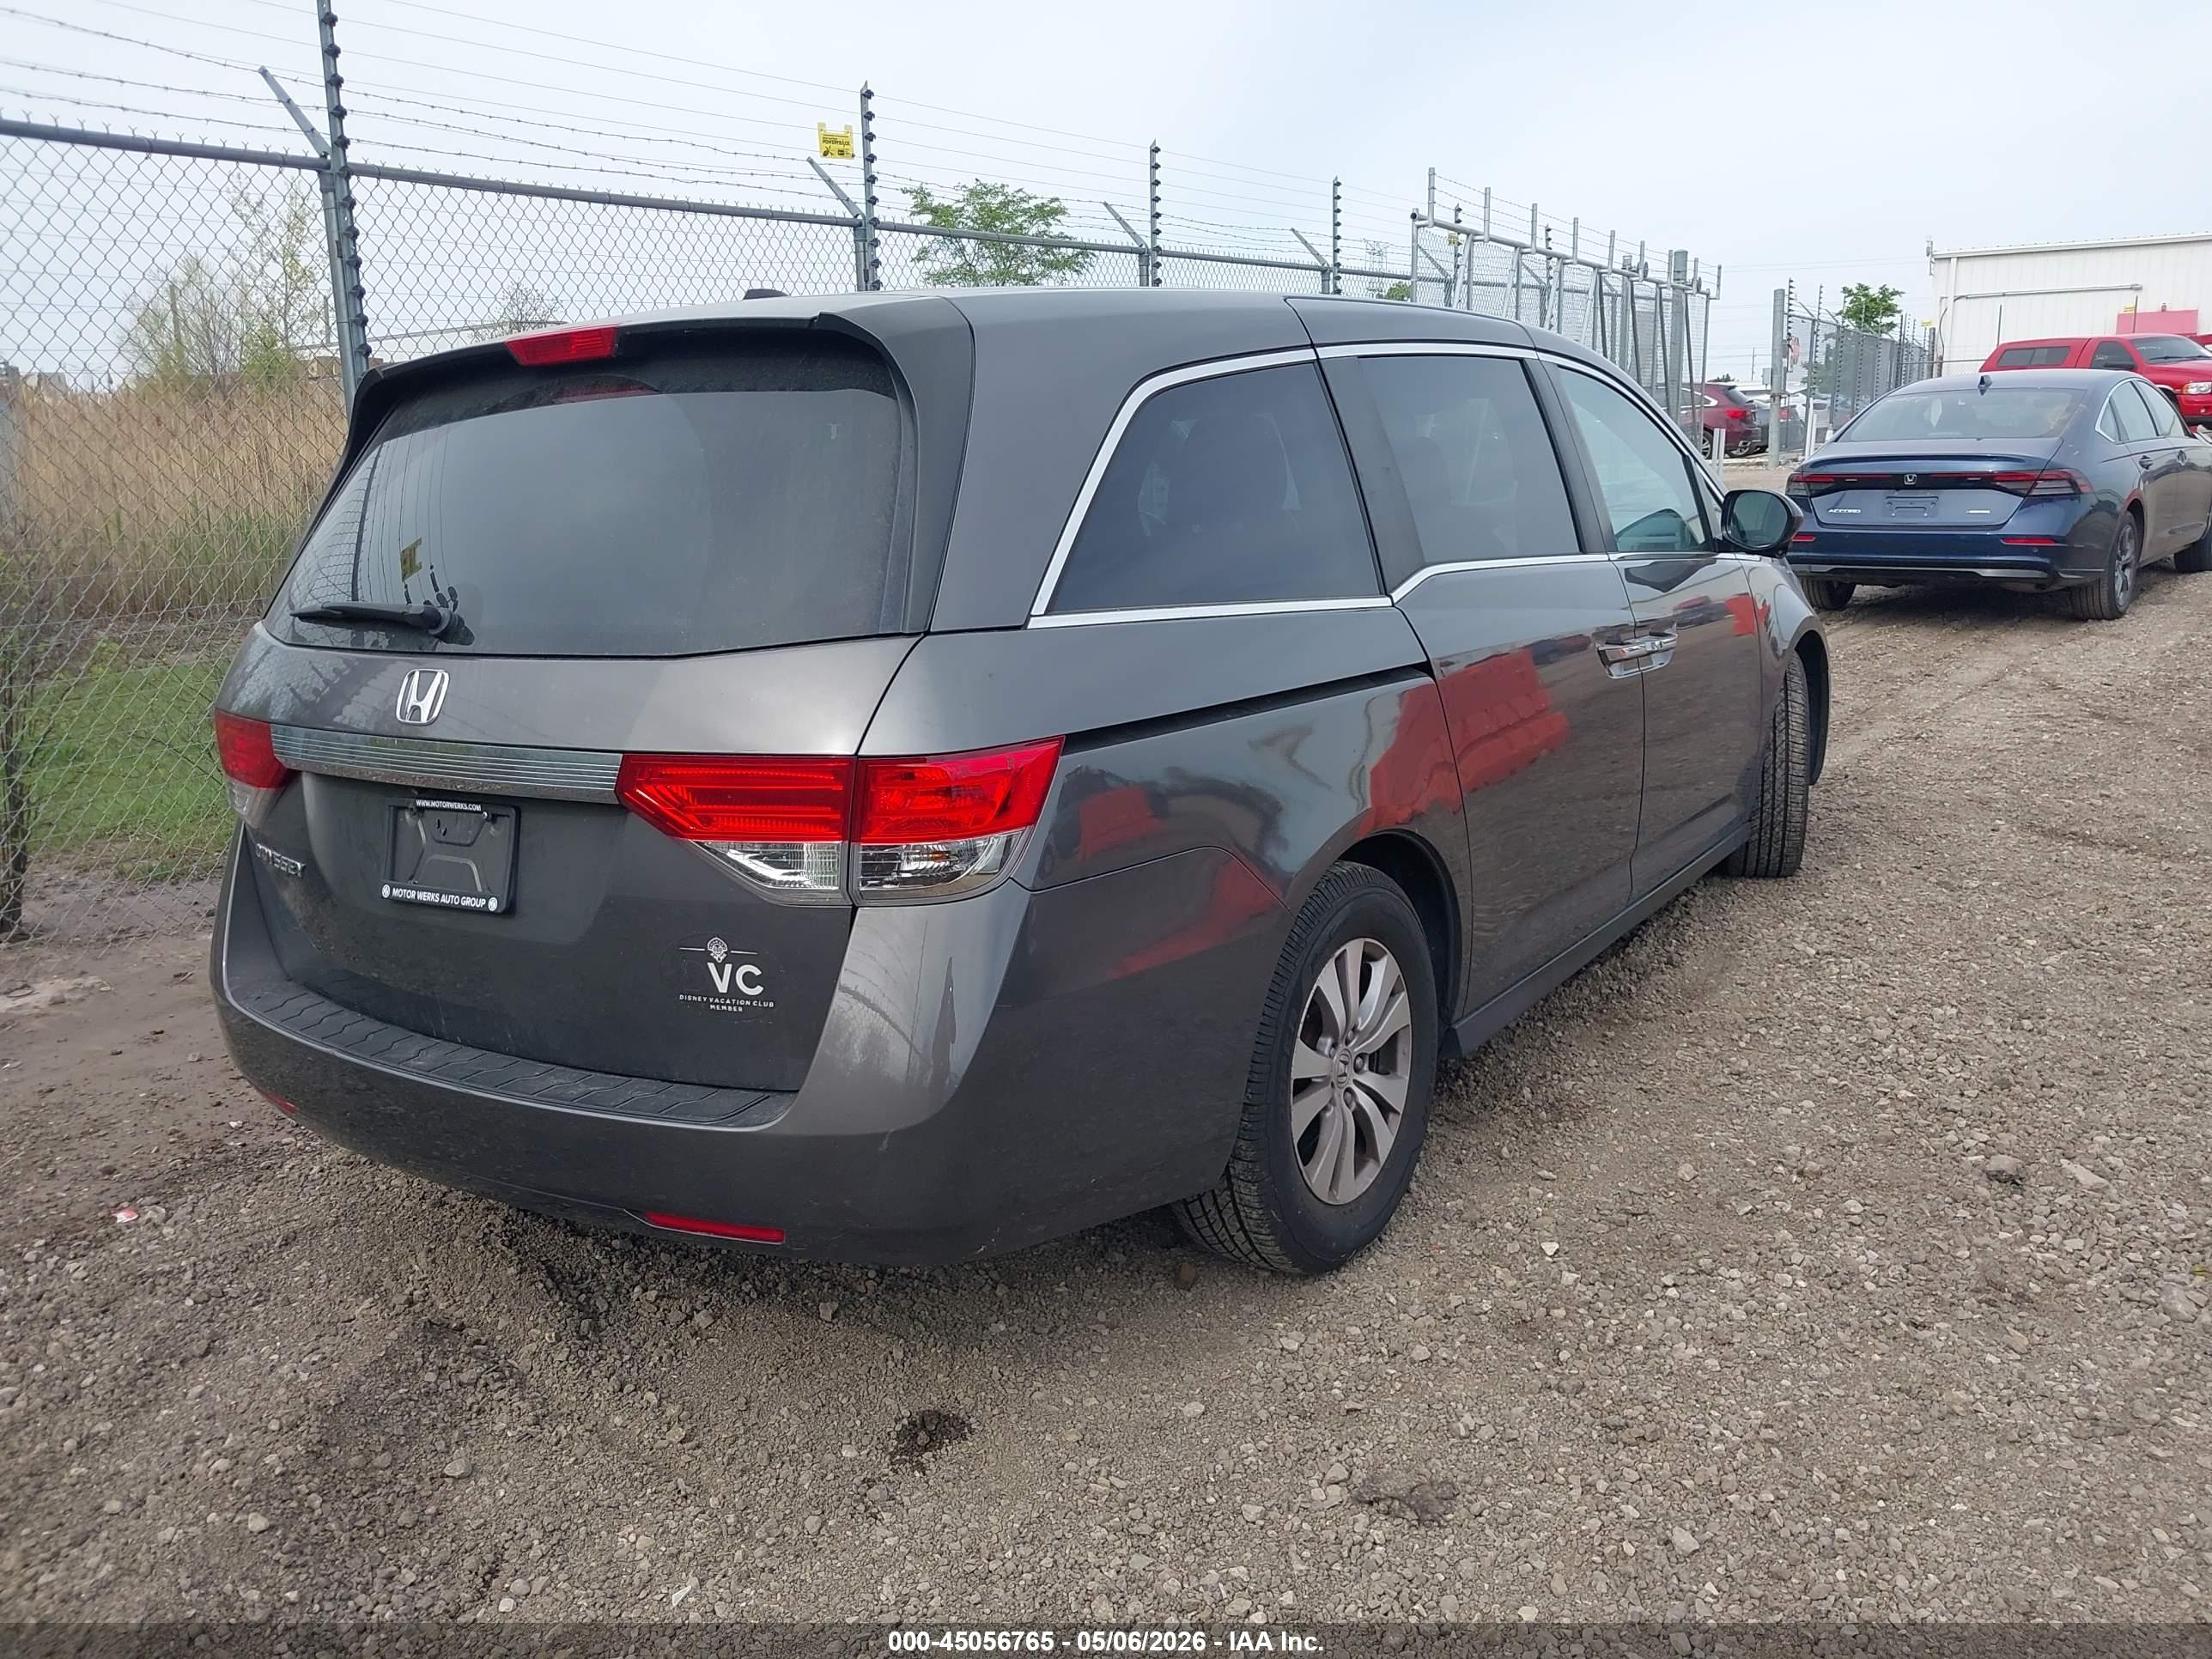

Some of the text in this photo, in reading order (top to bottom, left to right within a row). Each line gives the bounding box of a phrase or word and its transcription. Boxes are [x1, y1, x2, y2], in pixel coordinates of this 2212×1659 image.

[416, 799, 482, 811] WWW.MOTORWERKS.COM
[392, 888, 487, 908] MOTOR WERKS AUTO GROUP
[709, 997, 750, 1006] VACATION
